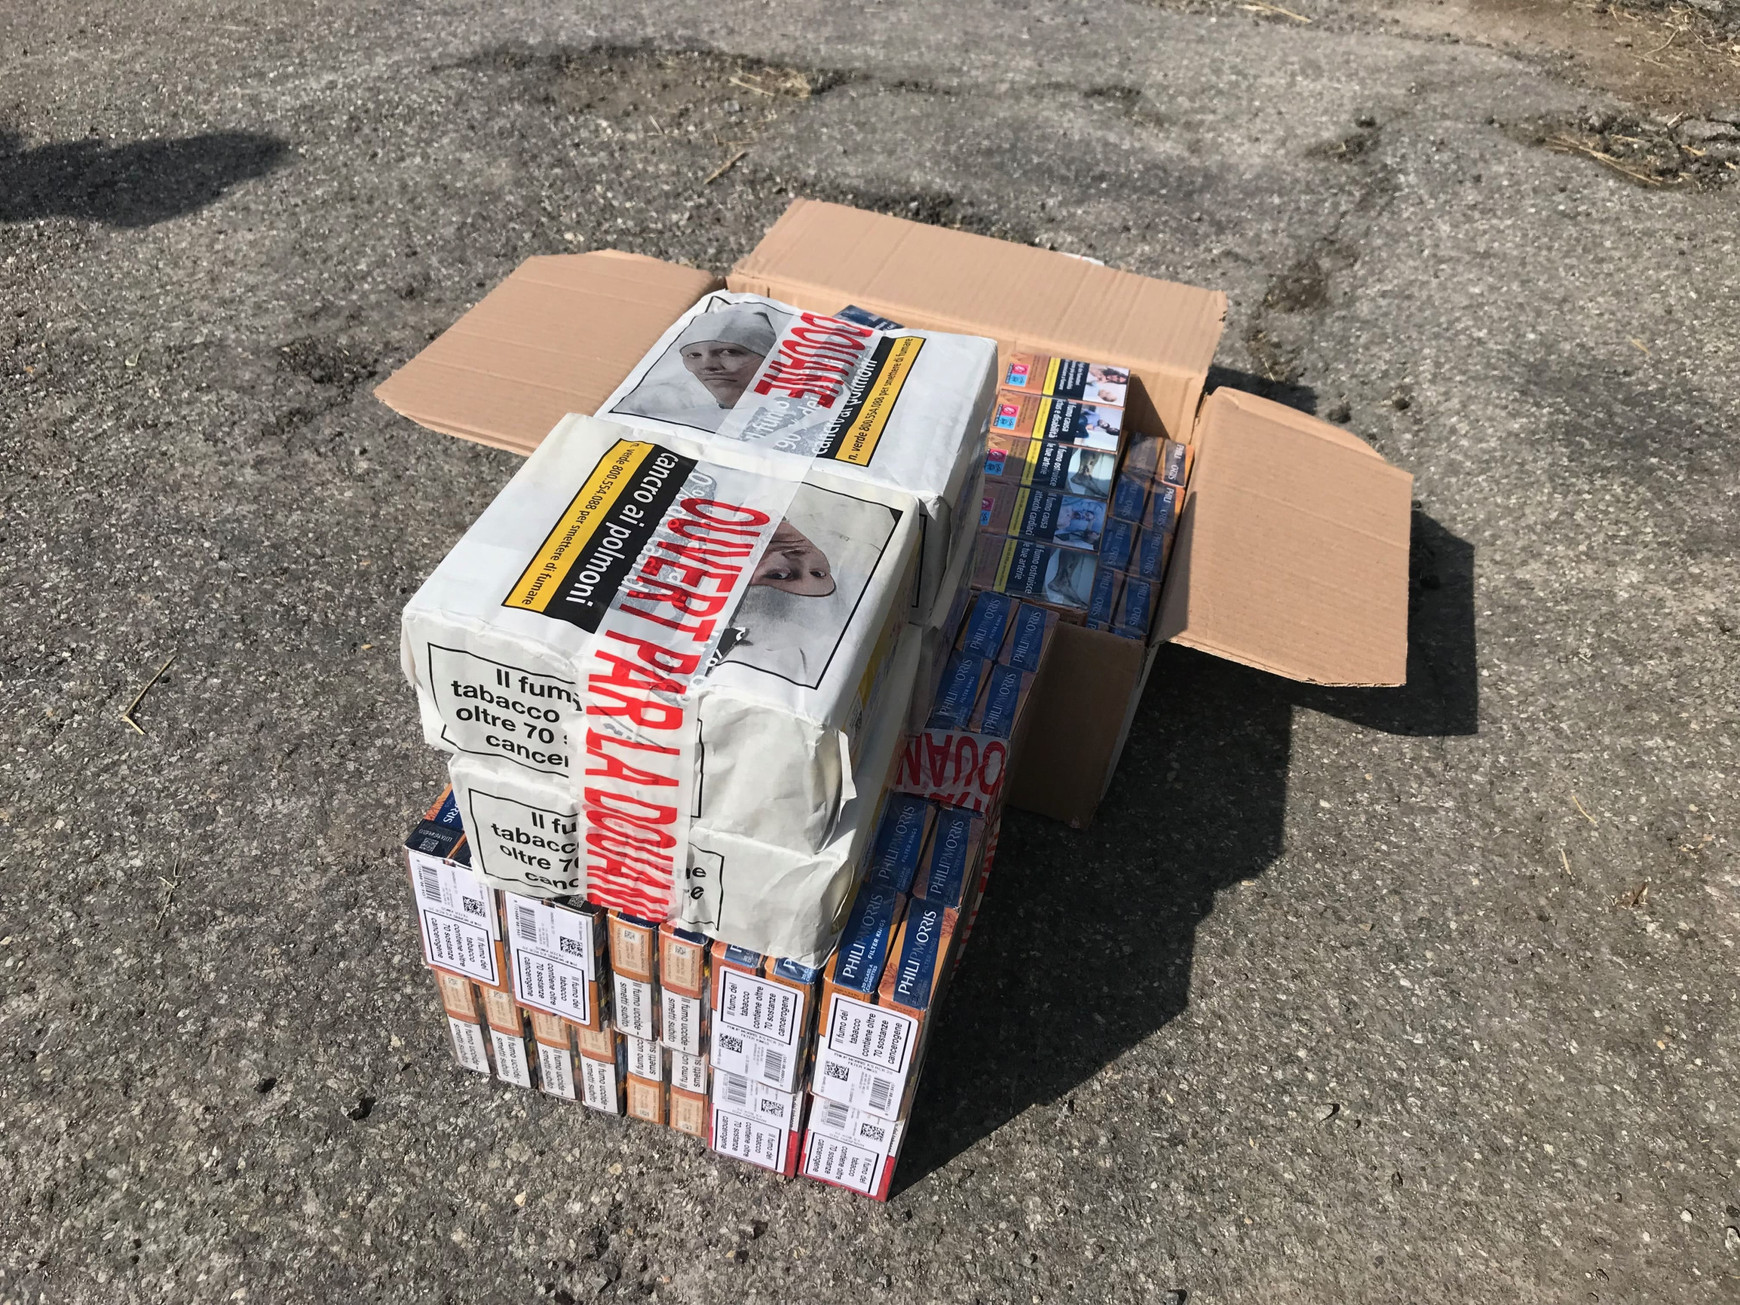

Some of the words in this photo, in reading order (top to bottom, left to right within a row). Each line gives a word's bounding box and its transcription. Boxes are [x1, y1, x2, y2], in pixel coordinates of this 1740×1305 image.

[899, 338, 914, 357] fumare
[884, 363, 901, 386] smettere
[879, 387, 890, 397] per
[859, 396, 885, 432] 800.554.088
[851, 432, 867, 452] verde
[616, 448, 635, 466] verde
[633, 452, 679, 503] cancro
[1050, 462, 1061, 487] ostruisce
[585, 465, 624, 510] 800.554.088
[620, 504, 645, 527] ai
[1044, 497, 1057, 511] fumo
[576, 510, 590, 524] per
[1025, 512, 1037, 536] cardiaci
[1040, 512, 1050, 529] causa
[551, 524, 580, 561] smettere
[1020, 548, 1030, 558] tue
[544, 562, 557, 573] di
[566, 522, 632, 607] polmoni
[1032, 548, 1044, 565] fumo
[620, 497, 770, 642] OUVERT
[1014, 558, 1027, 580] arterie
[1025, 565, 1038, 594] ostruisce
[522, 572, 552, 605] fumare
[496, 669, 510, 688] Il
[586, 629, 702, 730] PAR
[451, 681, 560, 723] tabacco
[456, 705, 516, 731] oltre
[524, 722, 555, 744] 70
[585, 726, 680, 787] LA
[531, 812, 545, 829] Il
[552, 820, 579, 836] fu
[500, 844, 551, 870] oltre
[524, 872, 579, 890] canc
[867, 938, 879, 960] FILTER
[524, 957, 534, 997] cancerogene
[536, 971, 545, 999] sostanze
[547, 963, 556, 990] contiene
[729, 982, 738, 994] del
[549, 991, 557, 1006] oltre
[560, 976, 568, 1002] tabacco
[619, 981, 629, 1006] smetti
[632, 987, 642, 1006] fumo
[755, 986, 764, 1002] oltre
[573, 998, 581, 1010] del
[668, 997, 677, 1021] smetti
[681, 1003, 691, 1022] fumo
[727, 994, 737, 1011] fumo
[740, 991, 750, 1017] tabacco
[767, 993, 777, 1022] sostanze
[620, 1005, 630, 1027] subito
[634, 1007, 643, 1030] uccide
[753, 1002, 762, 1029] contiene
[778, 995, 790, 1037] cancerogene
[840, 1009, 849, 1021] del
[866, 1013, 876, 1029] oltre
[668, 1020, 677, 1042] subito
[680, 1023, 690, 1046] uccide
[836, 1021, 847, 1038] fumo
[849, 1018, 861, 1045] tabacco
[876, 1020, 889, 1050] sostanze
[862, 1029, 873, 1057] contiene
[888, 1022, 903, 1065] cancerogene
[635, 1053, 644, 1070] fumo
[648, 1054, 656, 1075] smetti
[680, 1066, 688, 1083] fumo
[692, 1066, 701, 1088] smetti
